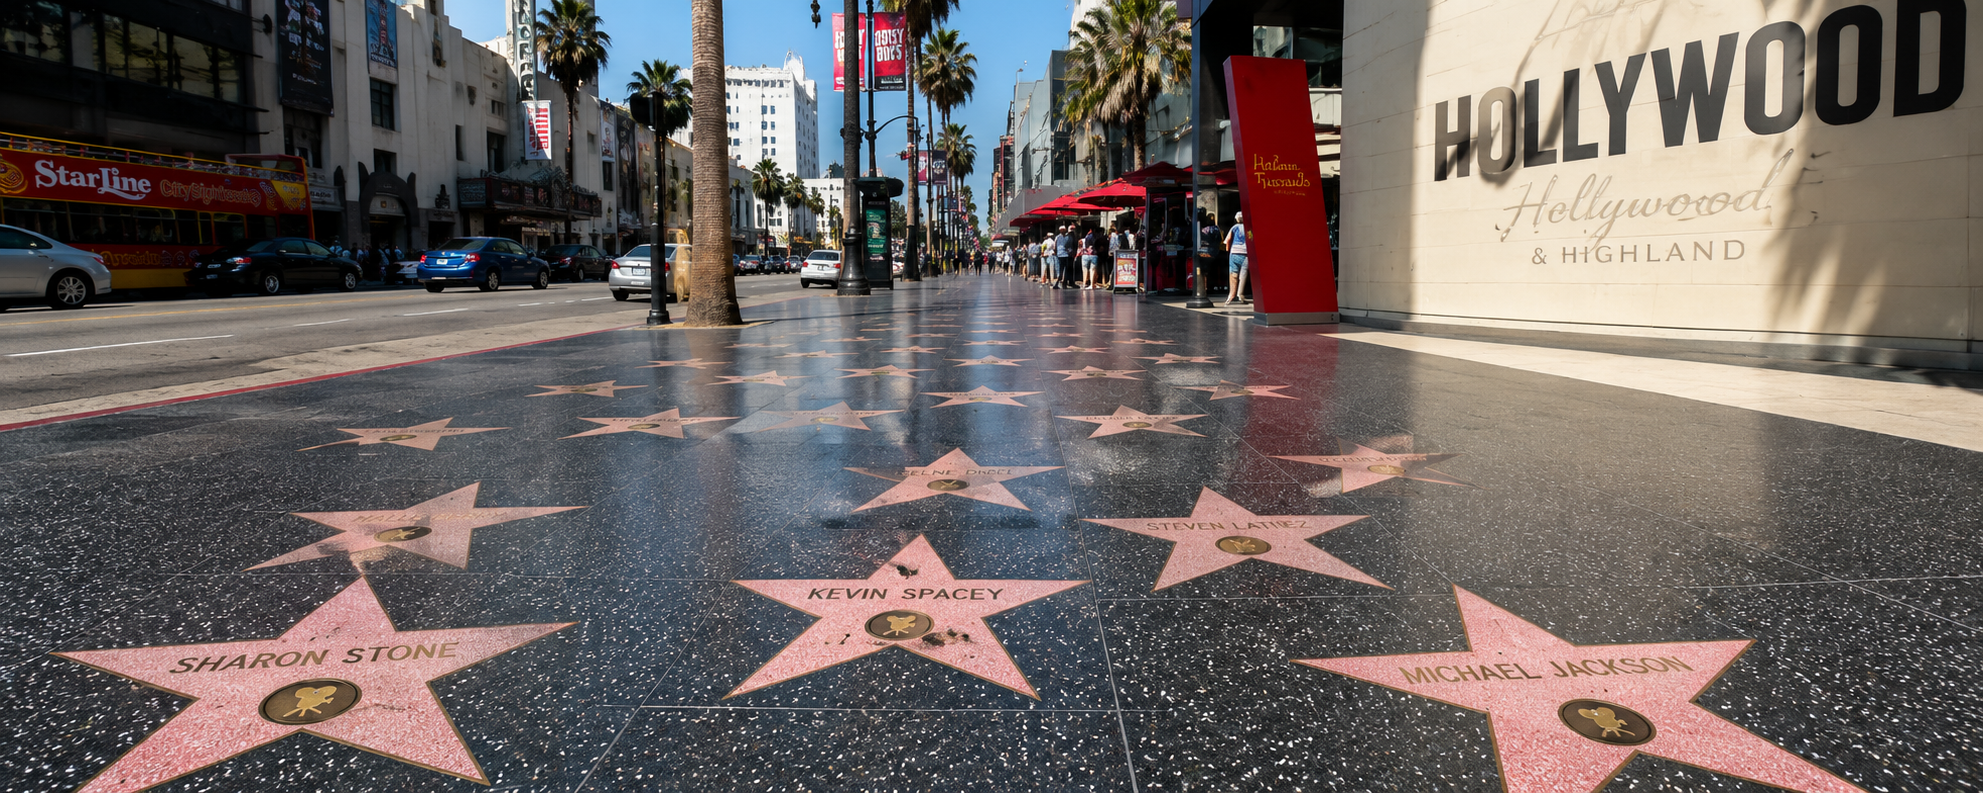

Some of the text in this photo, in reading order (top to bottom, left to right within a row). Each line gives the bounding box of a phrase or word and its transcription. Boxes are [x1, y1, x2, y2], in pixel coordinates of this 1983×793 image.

[1434, 0, 1967, 181] HOLLYWOOD
[34, 160, 152, 200] StarLine
[1531, 240, 1746, 265] & HIGHLAND
[1147, 522, 1225, 531] STEVEN
[807, 588, 1004, 600] KEVIN SPACEY
[169, 641, 460, 674] SHARON STONE
[1399, 655, 1696, 686] MICHAEL JACKSON
